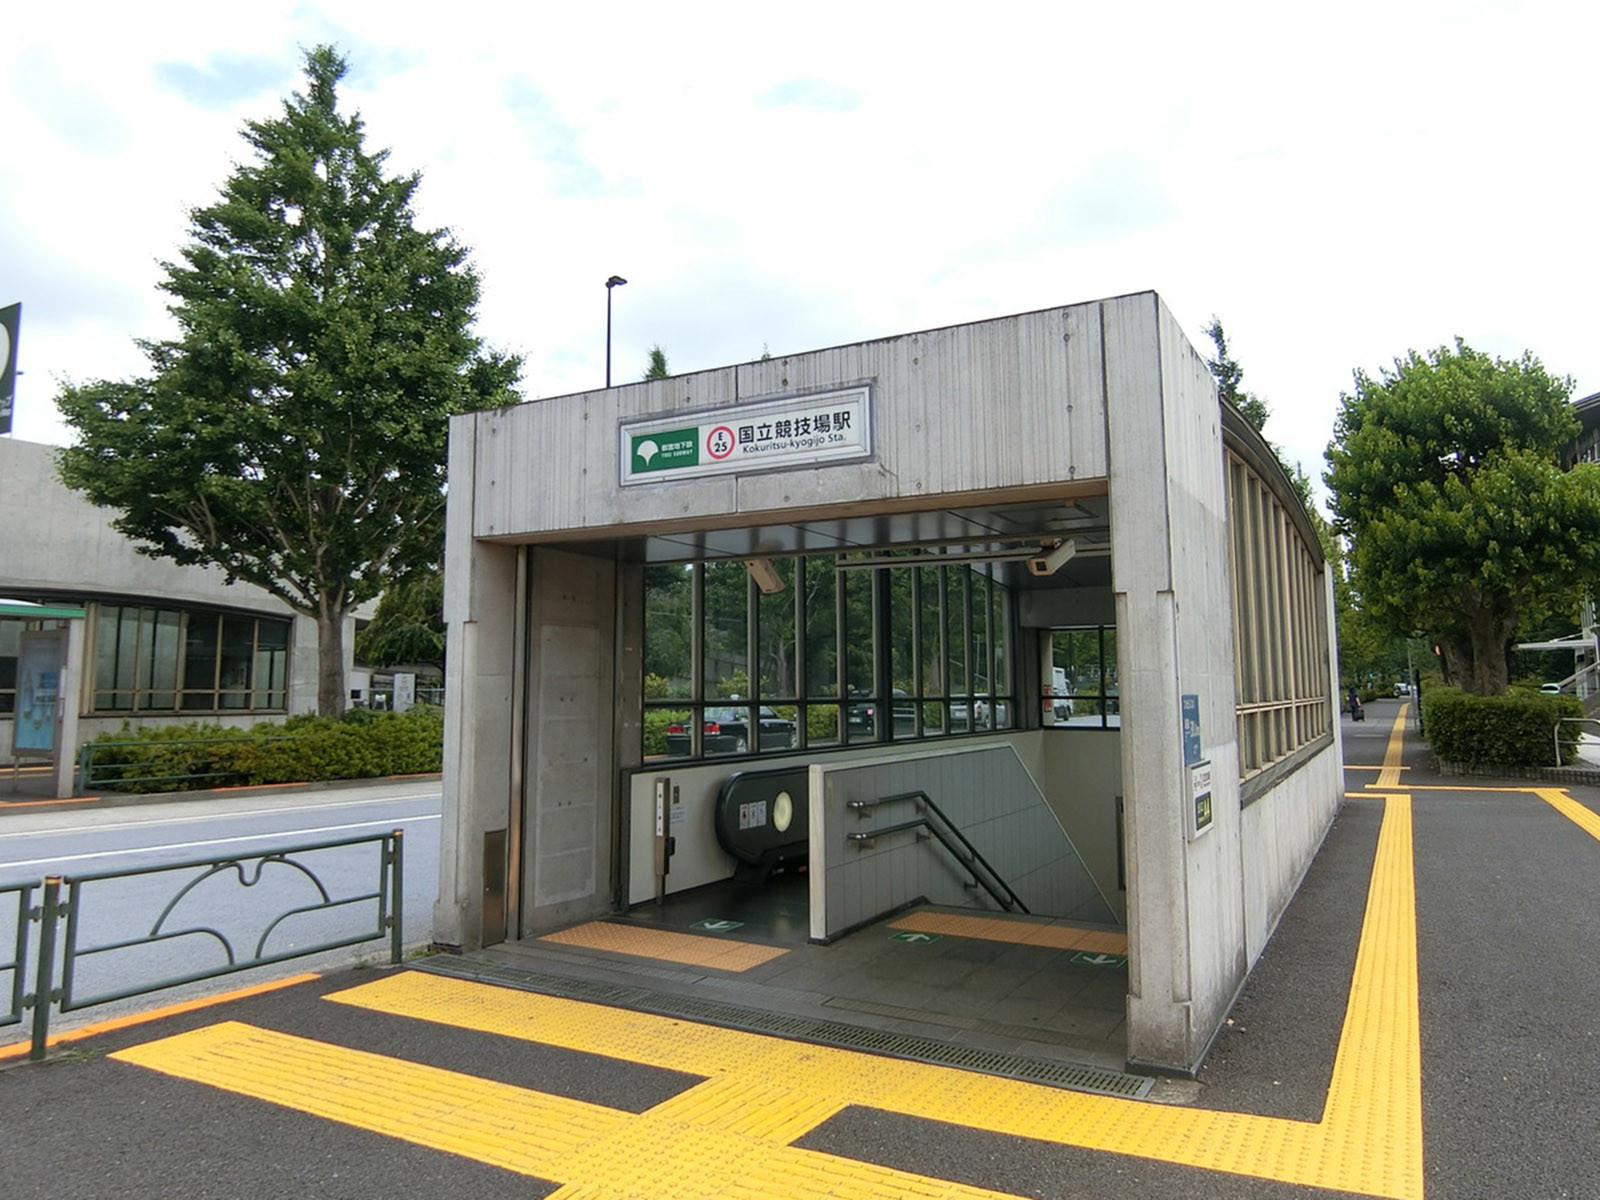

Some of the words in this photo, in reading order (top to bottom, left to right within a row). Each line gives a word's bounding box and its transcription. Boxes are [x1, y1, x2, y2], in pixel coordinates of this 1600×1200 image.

[739, 411, 851, 444] 国立競技場駅
[718, 432, 723, 441] E
[743, 435, 825, 454] Kokuritsu-kyogijo
[828, 433, 846, 443] Sta.
[714, 441, 728, 453] 25
